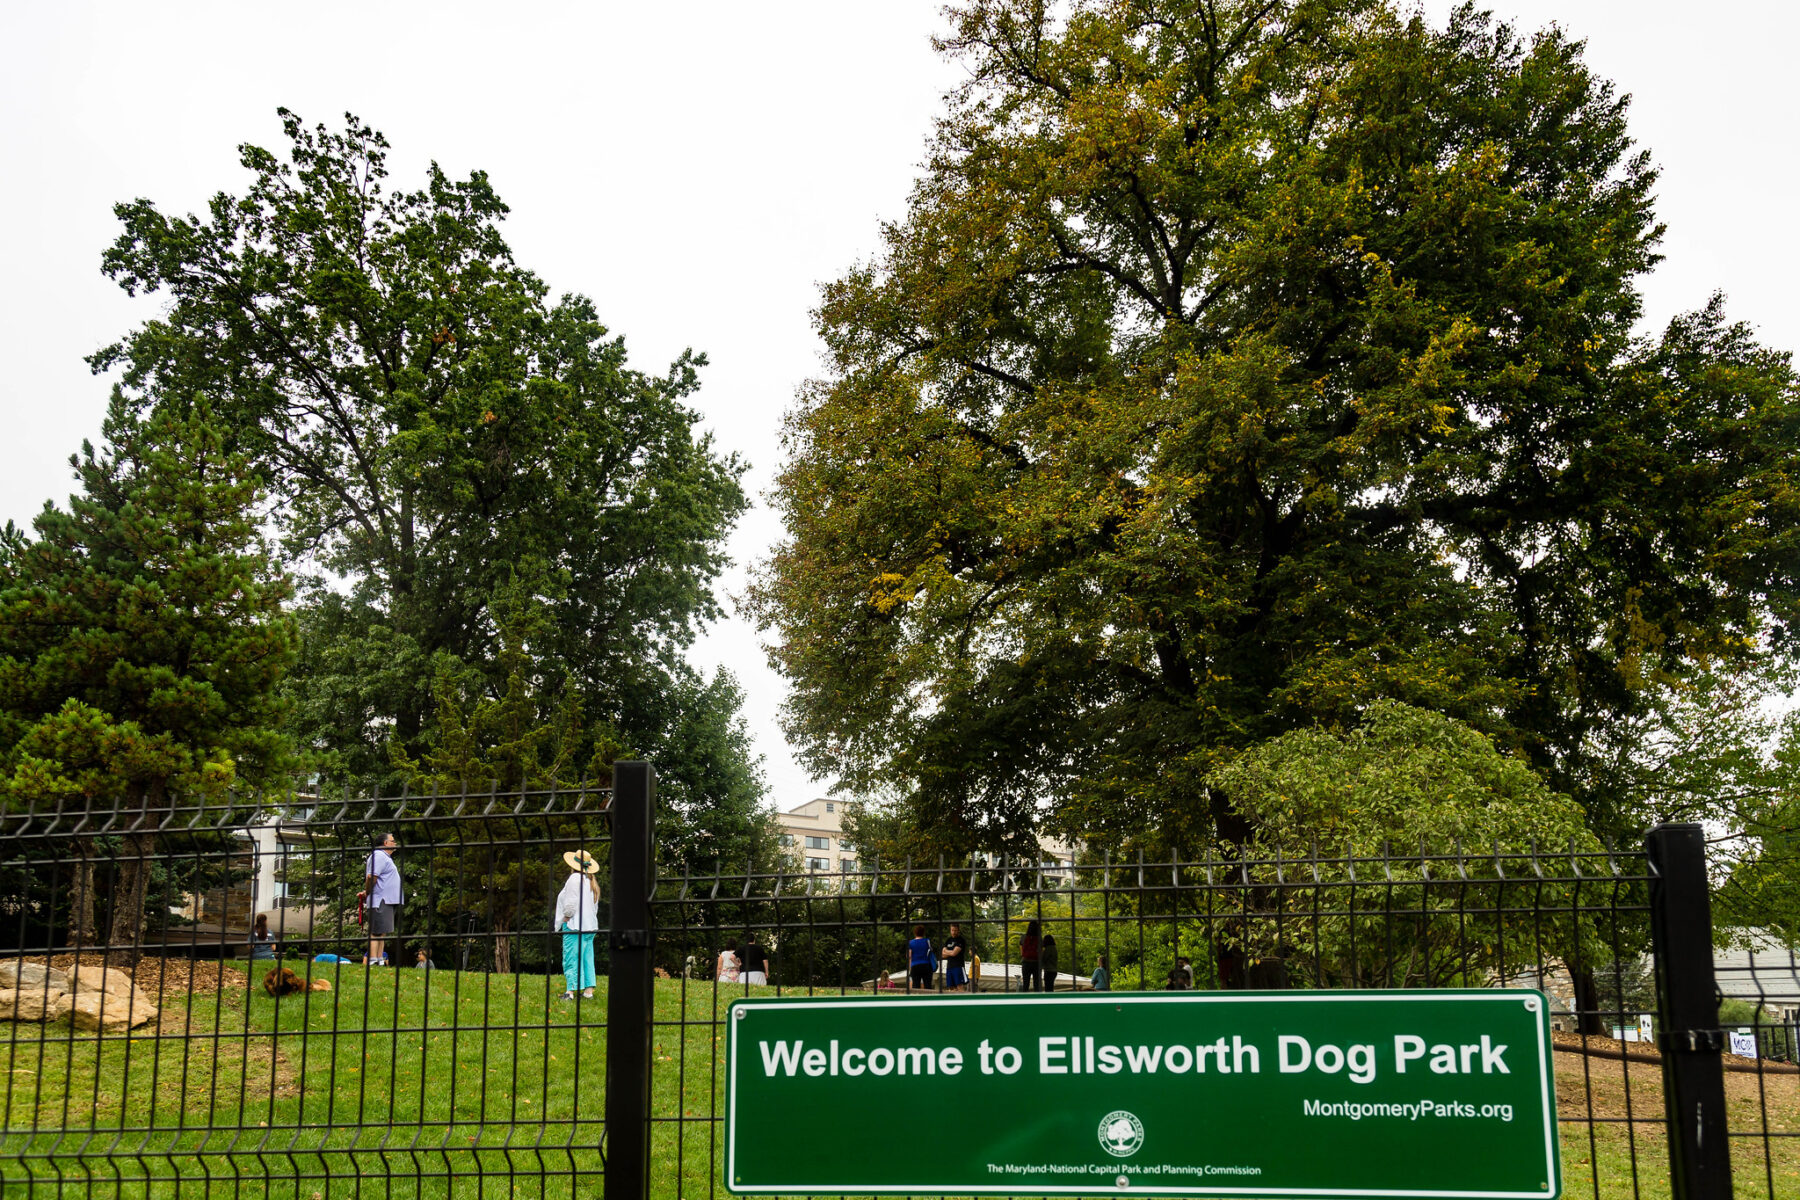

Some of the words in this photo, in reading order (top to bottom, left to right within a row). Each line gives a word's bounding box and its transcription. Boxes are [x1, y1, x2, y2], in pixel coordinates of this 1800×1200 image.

[759, 1039, 964, 1077] Welcome
[977, 1038, 1023, 1075] to
[1038, 1035, 1260, 1074] Ellsworth
[1277, 1034, 1376, 1084] Dog
[1394, 1033, 1511, 1074] Park
[1303, 1098, 1514, 1123] MontgomeryParks.org
[987, 1163, 1004, 1174] The
[1005, 1163, 1087, 1175] Maryland-National
[1088, 1163, 1120, 1175] Capital
[1121, 1163, 1142, 1174] Park
[1143, 1164, 1161, 1174] and
[1162, 1164, 1203, 1176] Planning
[1204, 1165, 1262, 1175] Commission
